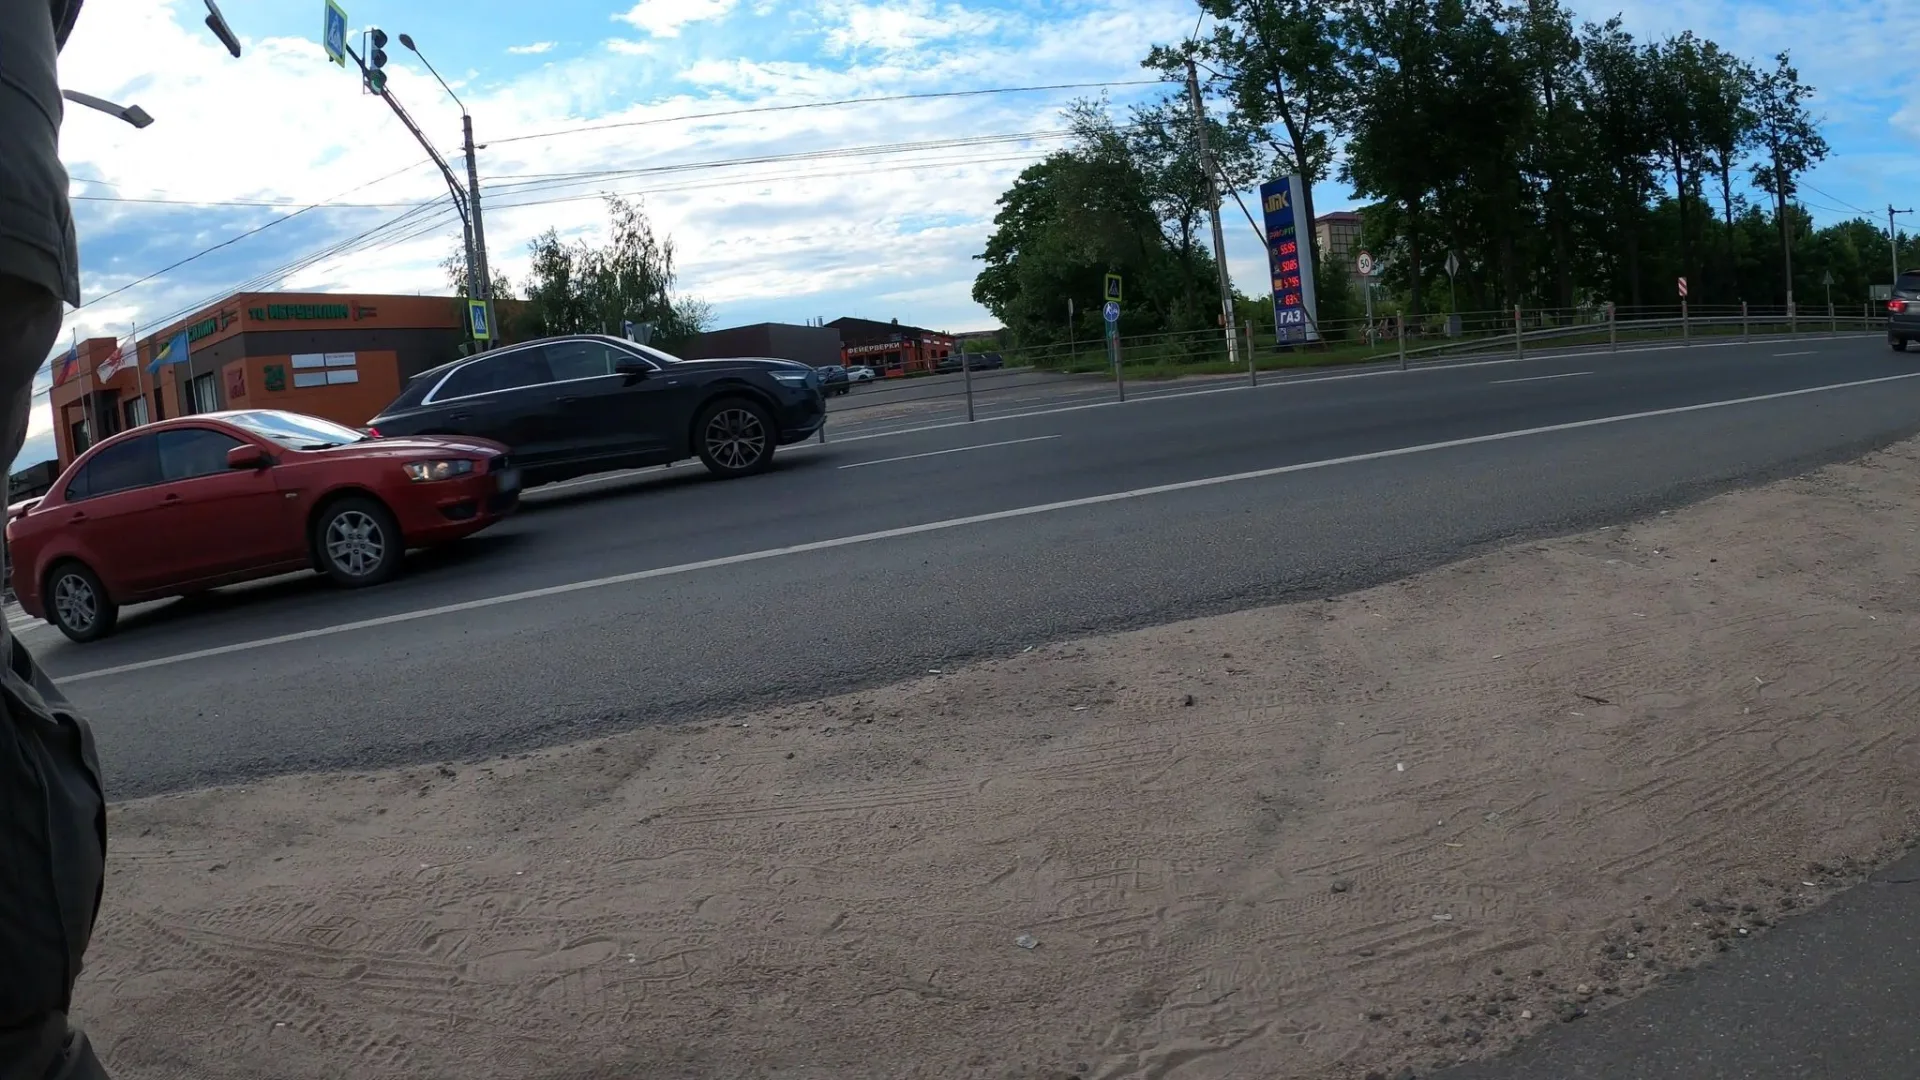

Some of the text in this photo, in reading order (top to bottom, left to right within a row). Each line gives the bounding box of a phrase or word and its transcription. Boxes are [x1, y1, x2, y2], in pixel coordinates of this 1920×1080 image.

[1360, 259, 1370, 268] 50
[1280, 310, 1301, 325] ГАЗ
[847, 342, 900, 354] ФЕЙЕРВЕРКИ
